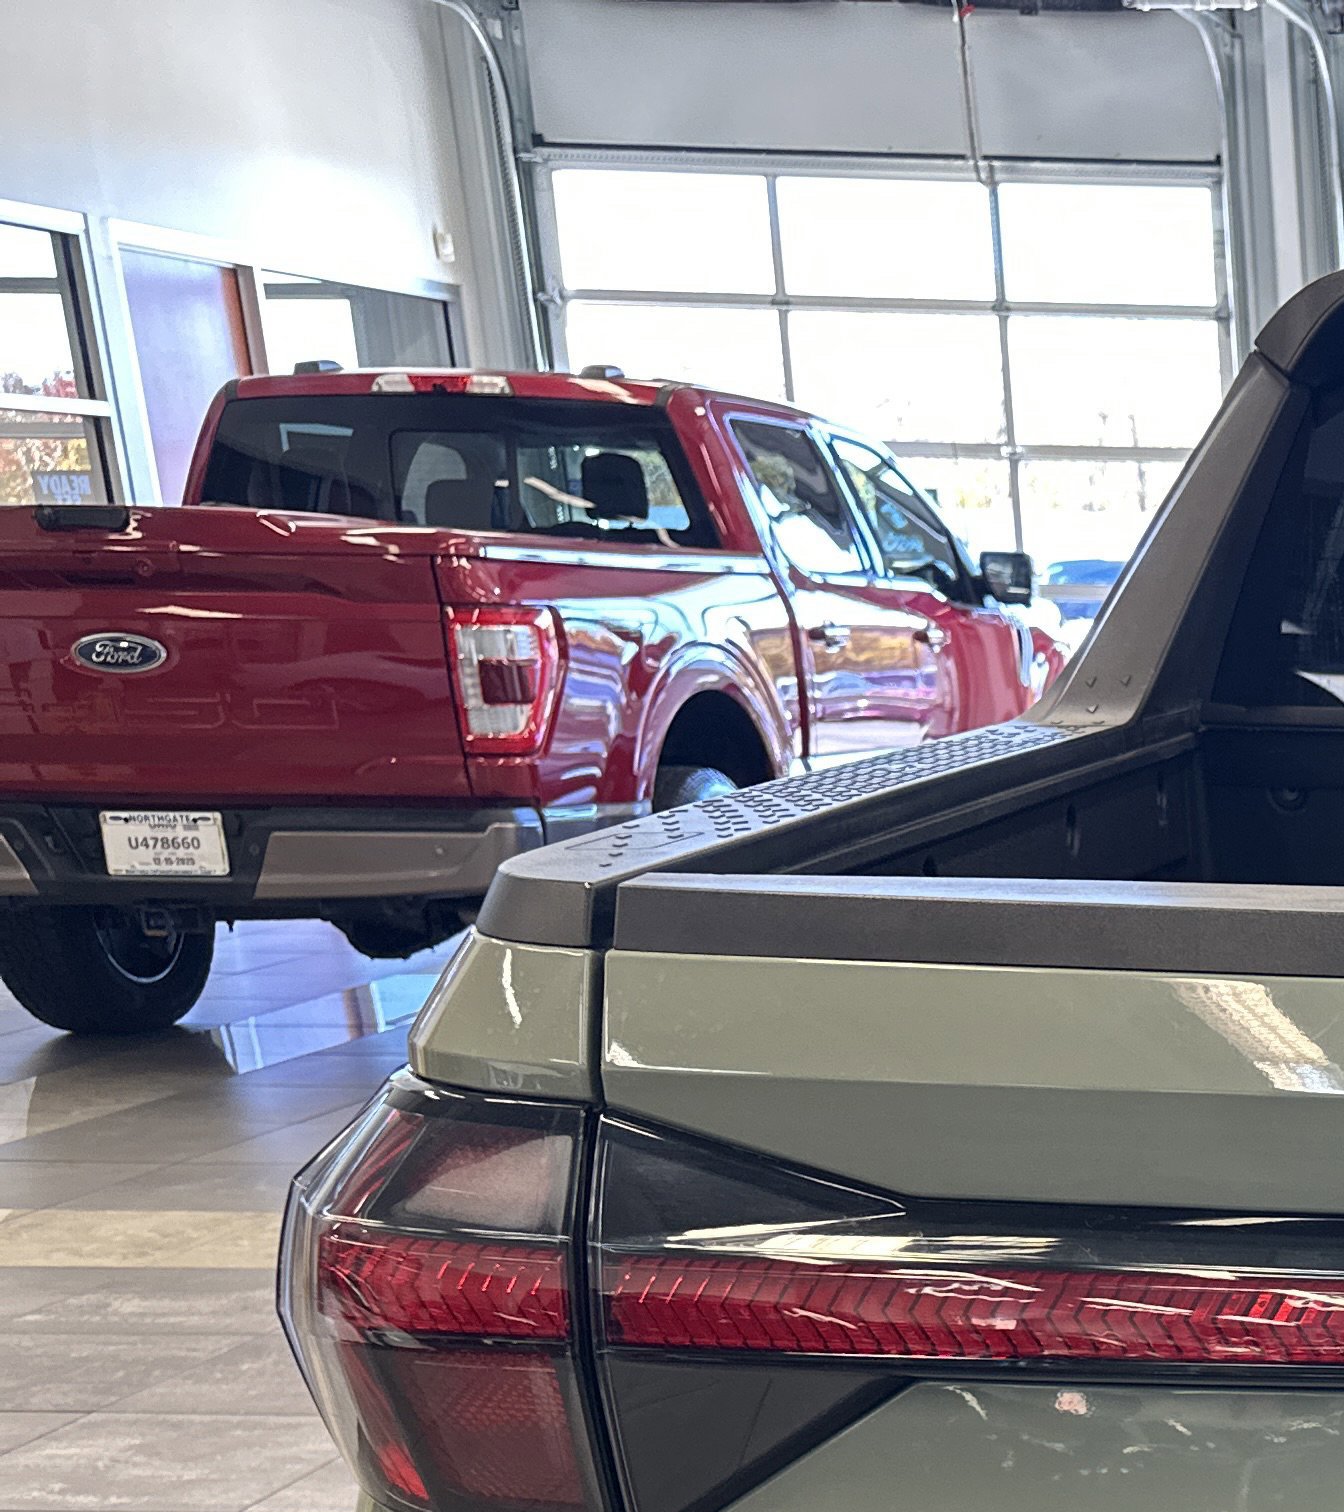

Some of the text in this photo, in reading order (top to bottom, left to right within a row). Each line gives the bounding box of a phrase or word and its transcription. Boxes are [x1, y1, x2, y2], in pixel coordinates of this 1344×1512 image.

[91, 640, 144, 665] Ford
[128, 814, 191, 824] NORTHGATE
[127, 836, 201, 850] U478660
